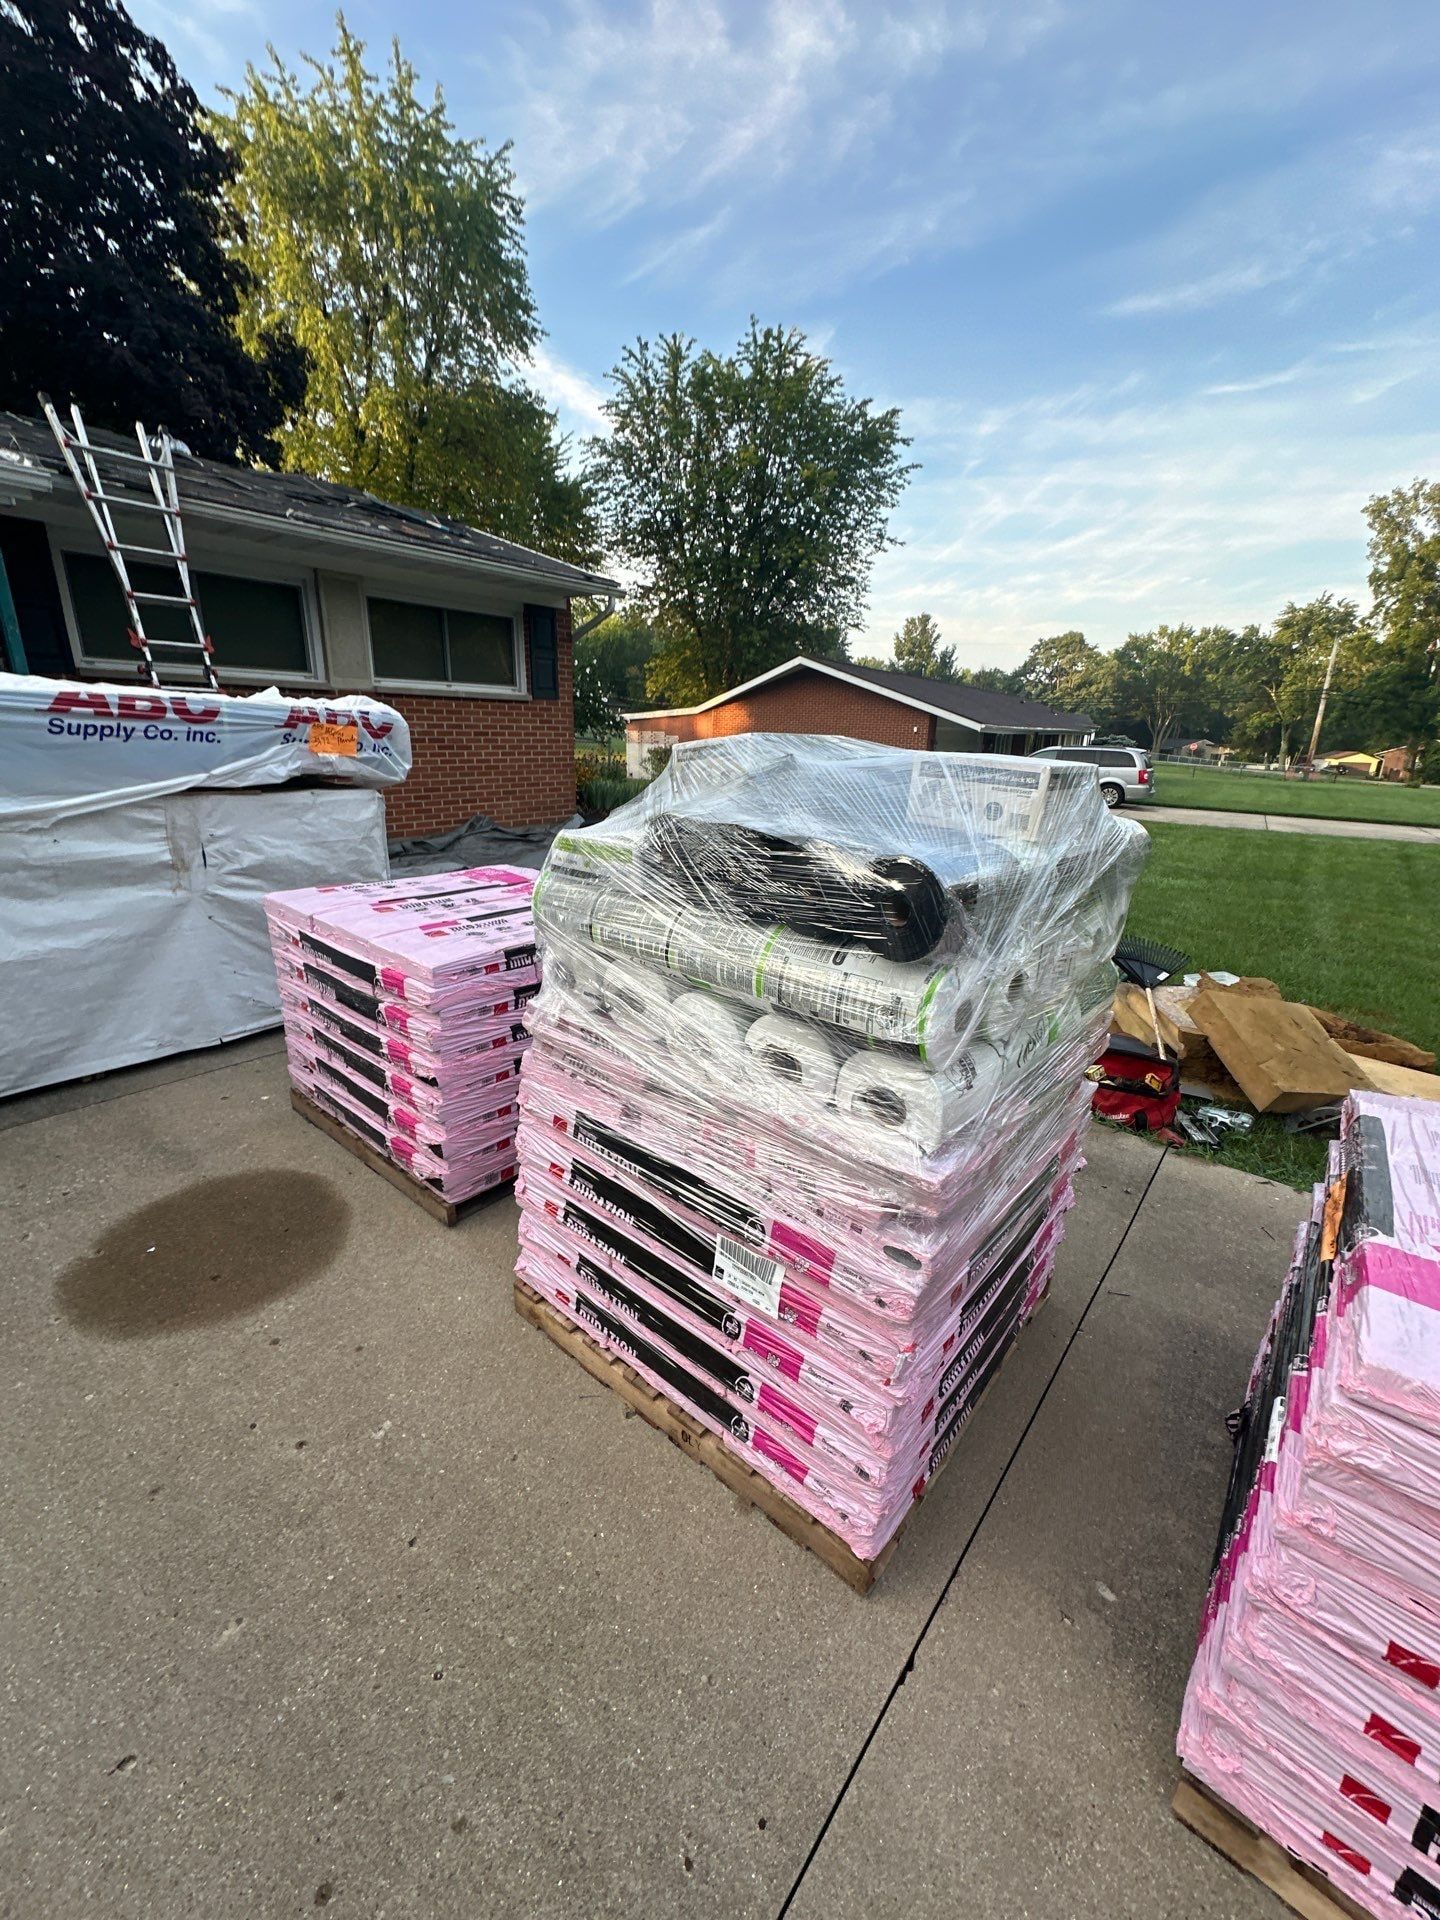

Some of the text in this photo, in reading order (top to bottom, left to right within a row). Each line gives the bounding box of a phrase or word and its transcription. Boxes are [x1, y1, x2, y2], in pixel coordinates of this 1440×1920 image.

[47, 717, 222, 744] Supply Co. inc.
